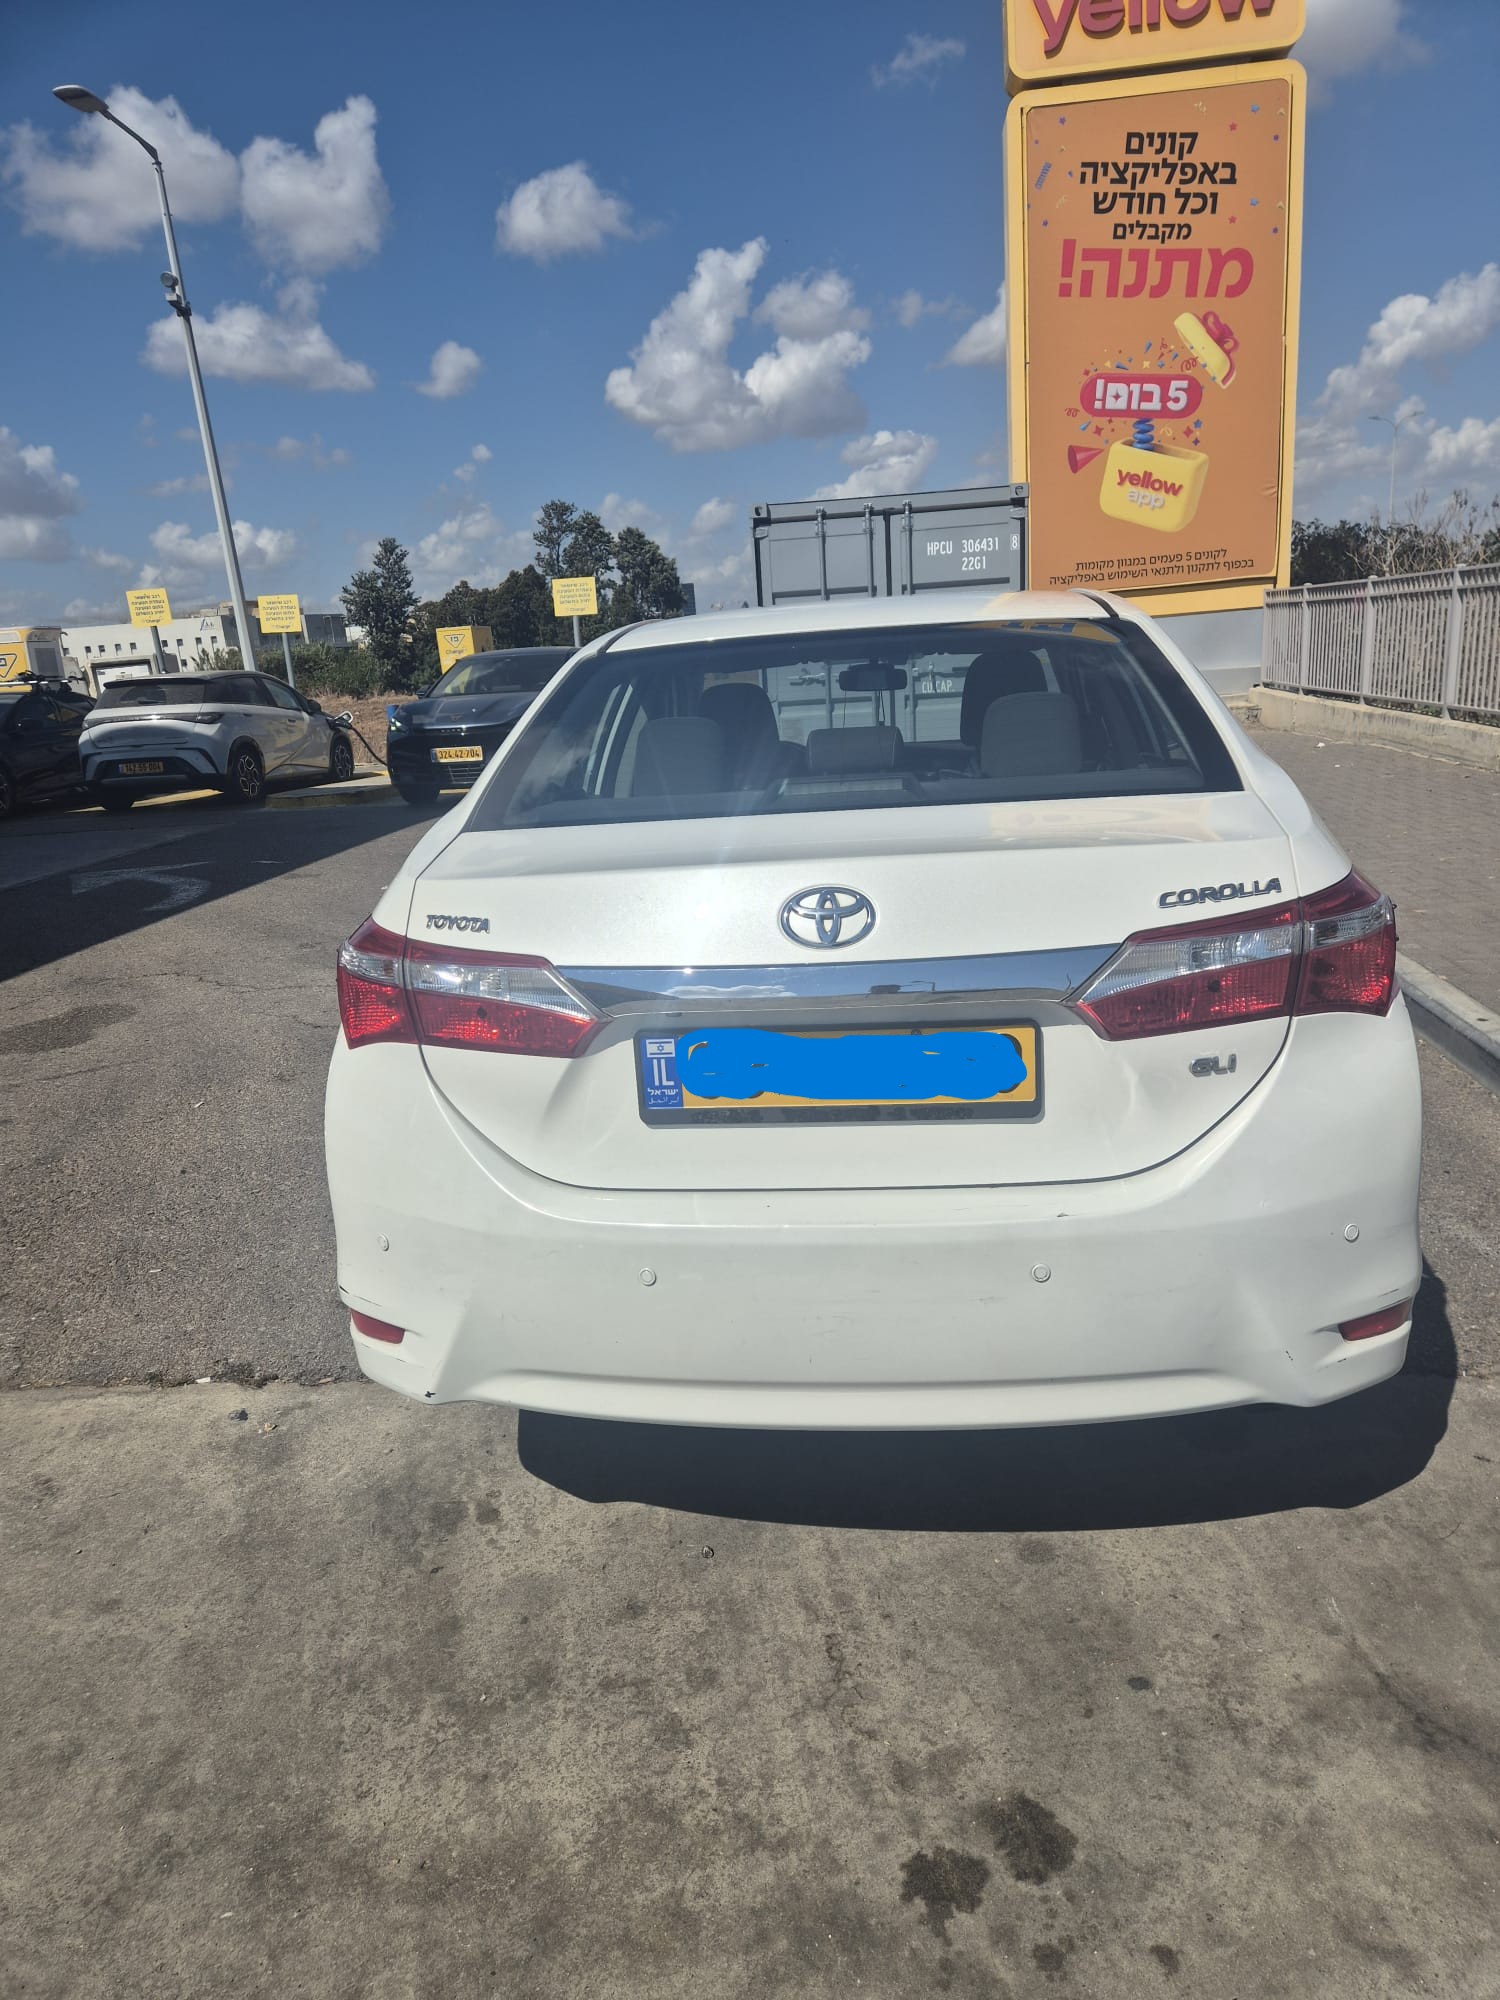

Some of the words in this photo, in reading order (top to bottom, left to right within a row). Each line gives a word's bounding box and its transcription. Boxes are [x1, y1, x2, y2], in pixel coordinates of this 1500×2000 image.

[1124, 131, 1199, 160] קונים
[1079, 158, 1238, 190] באפליקציה
[1092, 191, 1167, 215] חודש
[1173, 188, 1219, 215] וכל
[1112, 220, 1192, 245] מקבלים
[1057, 238, 1255, 299] מתנה!
[1093, 378, 1162, 411] בום!
[1166, 379, 1190, 412] 5
[1116, 468, 1184, 497] yellow
[1127, 489, 1165, 510] app
[927, 540, 953, 556] HPCU
[961, 536, 999, 553] 306431
[1011, 534, 1019, 550] 8
[1194, 547, 1228, 561] לקונים
[961, 556, 986, 571] 22G1
[1075, 559, 1115, 572] מקומות
[1116, 556, 1147, 569] במגוון
[1149, 552, 1183, 565] פעמים
[1185, 551, 1192, 561] 5
[1223, 557, 1255, 571] בכפוף
[1107, 567, 1149, 580] השימוש
[1149, 563, 1185, 577] ולתנאי
[1187, 559, 1221, 574] לתקנון
[1049, 570, 1106, 586] באפליקציה
[1158, 877, 1283, 909] COROLLA
[425, 914, 490, 934] TOYOTA
[652, 1058, 675, 1087] IL
[647, 1087, 679, 1096] ישראל
